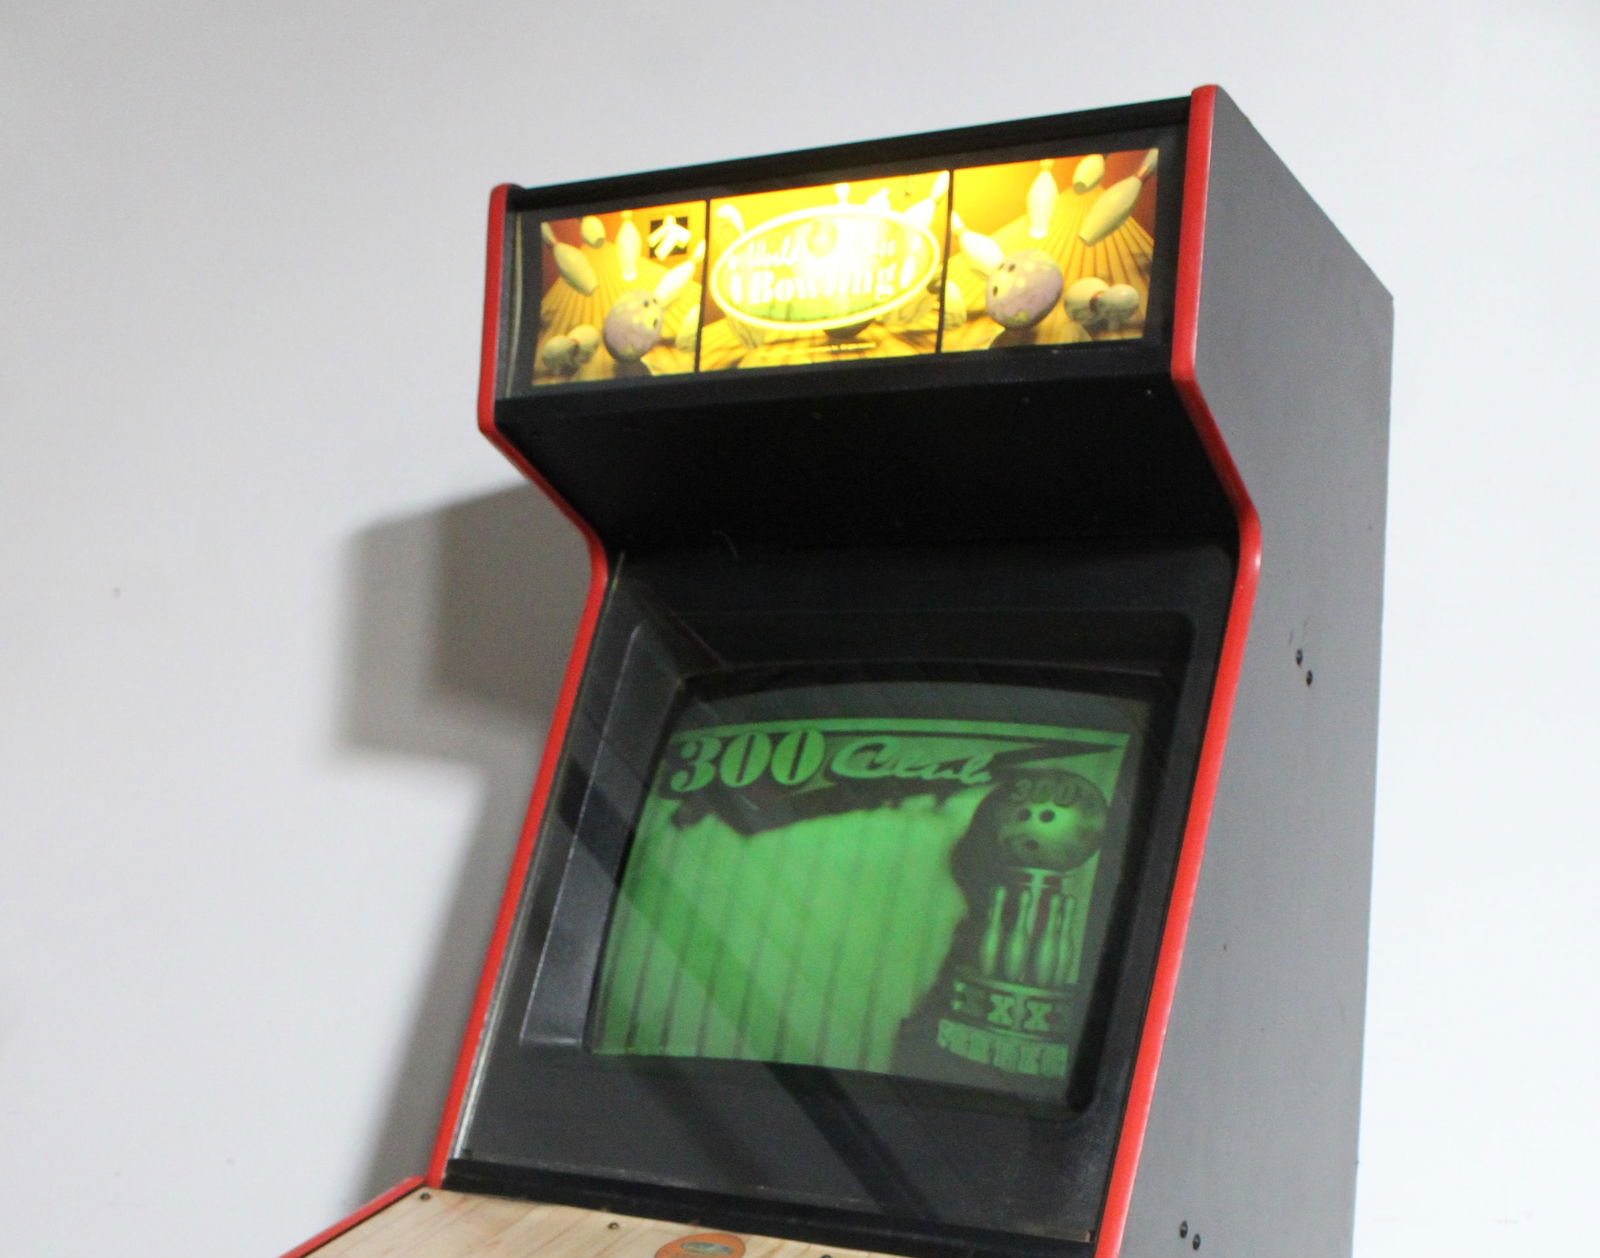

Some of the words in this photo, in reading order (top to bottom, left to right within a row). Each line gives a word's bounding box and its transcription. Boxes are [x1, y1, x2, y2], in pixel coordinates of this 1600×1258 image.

[749, 262, 896, 304] Bowling
[670, 729, 824, 793] 300
[831, 735, 994, 784] Club
